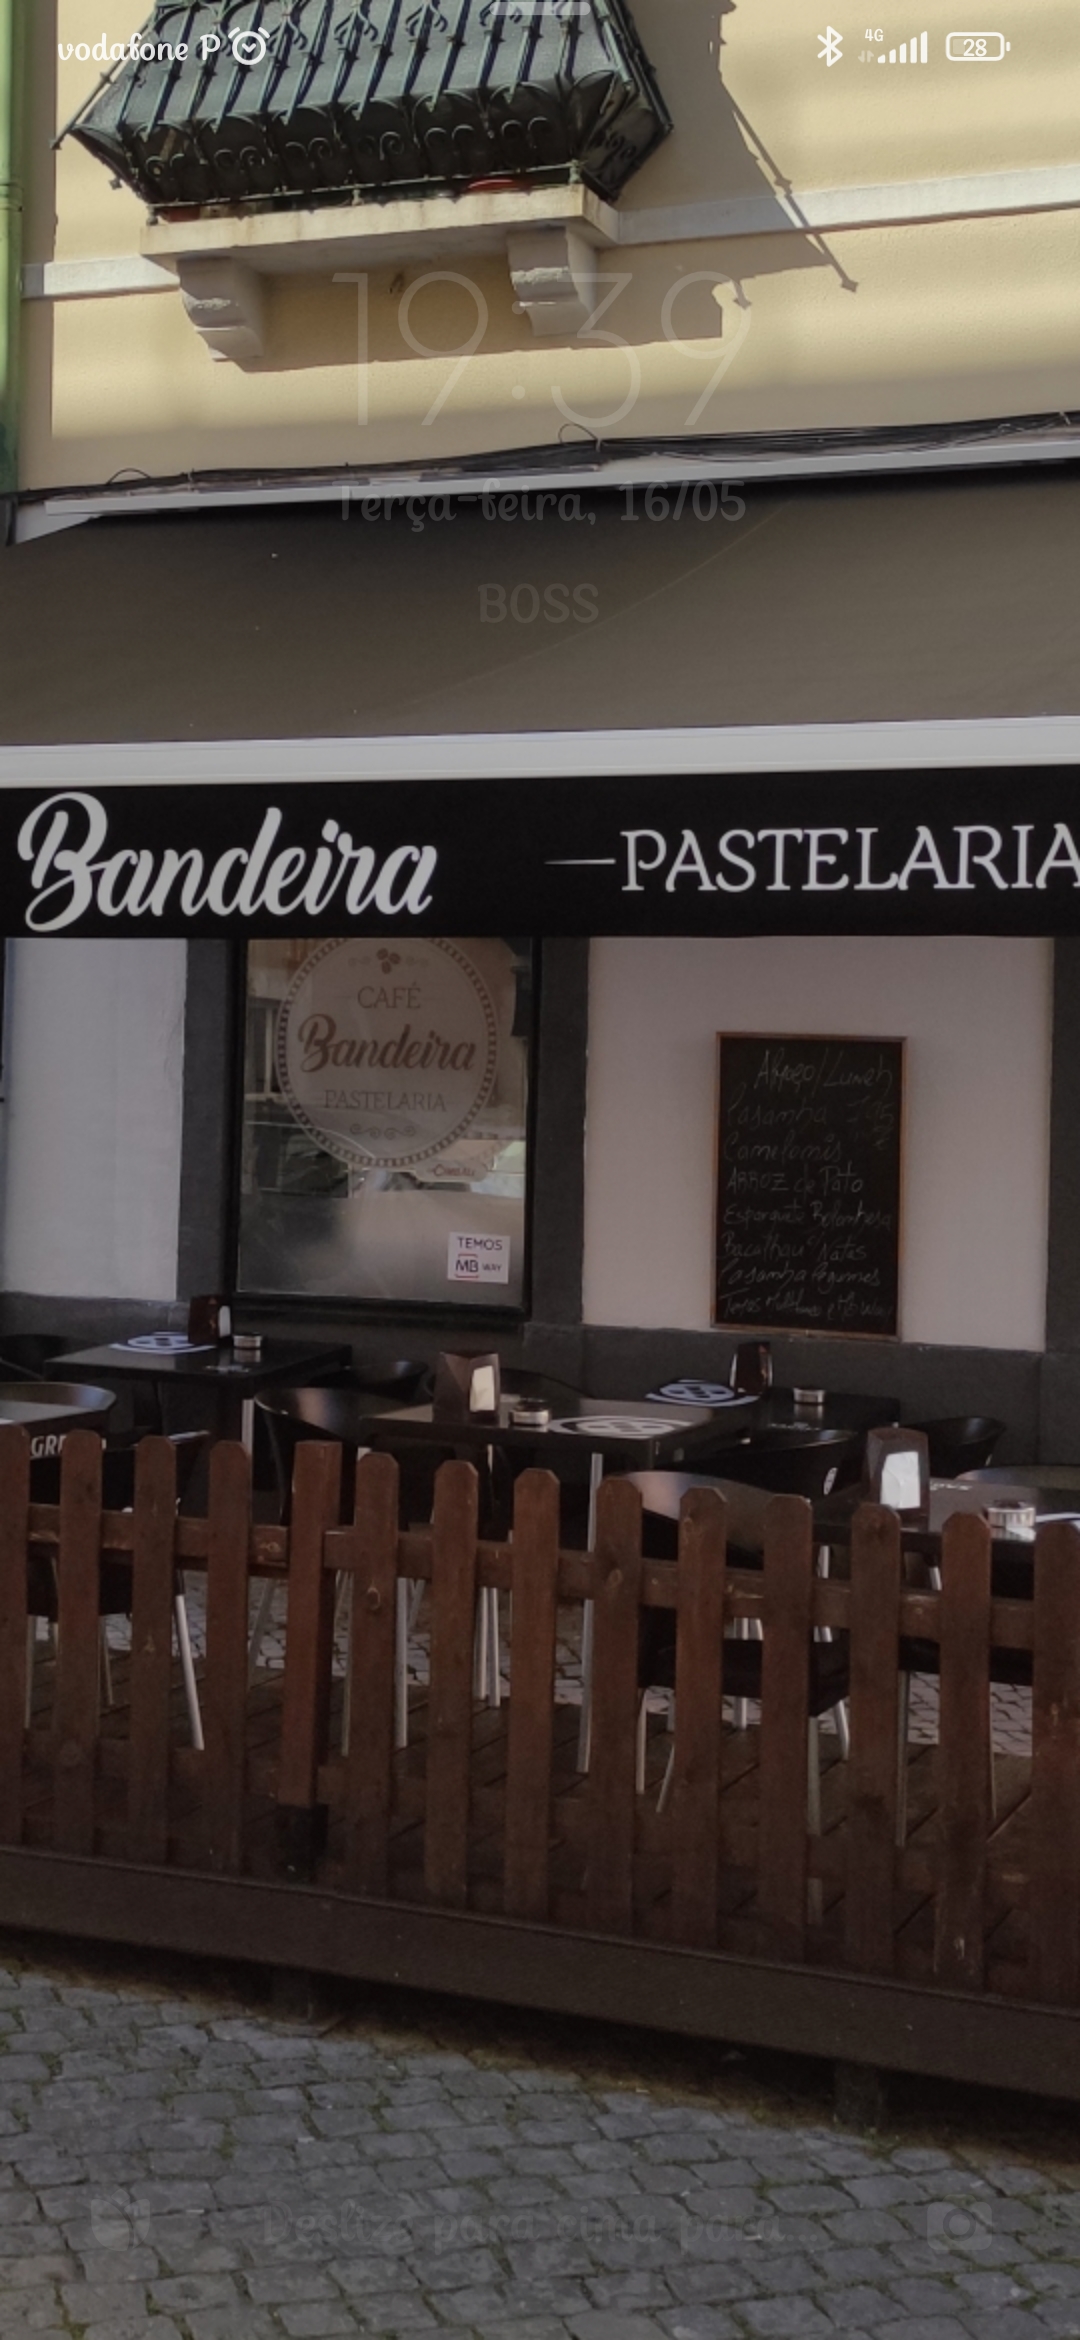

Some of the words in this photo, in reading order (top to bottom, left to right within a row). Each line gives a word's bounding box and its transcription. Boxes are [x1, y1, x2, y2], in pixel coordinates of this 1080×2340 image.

[17, 791, 438, 933] Bandeira
[620, 822, 1080, 893] PASTELARIA
[357, 981, 422, 1009] CAFÉ
[297, 1013, 477, 1073] Bandeira
[324, 1089, 448, 1112] PASTELARIA
[457, 1236, 503, 1251] TEMOS
[455, 1259, 479, 1273] MB
